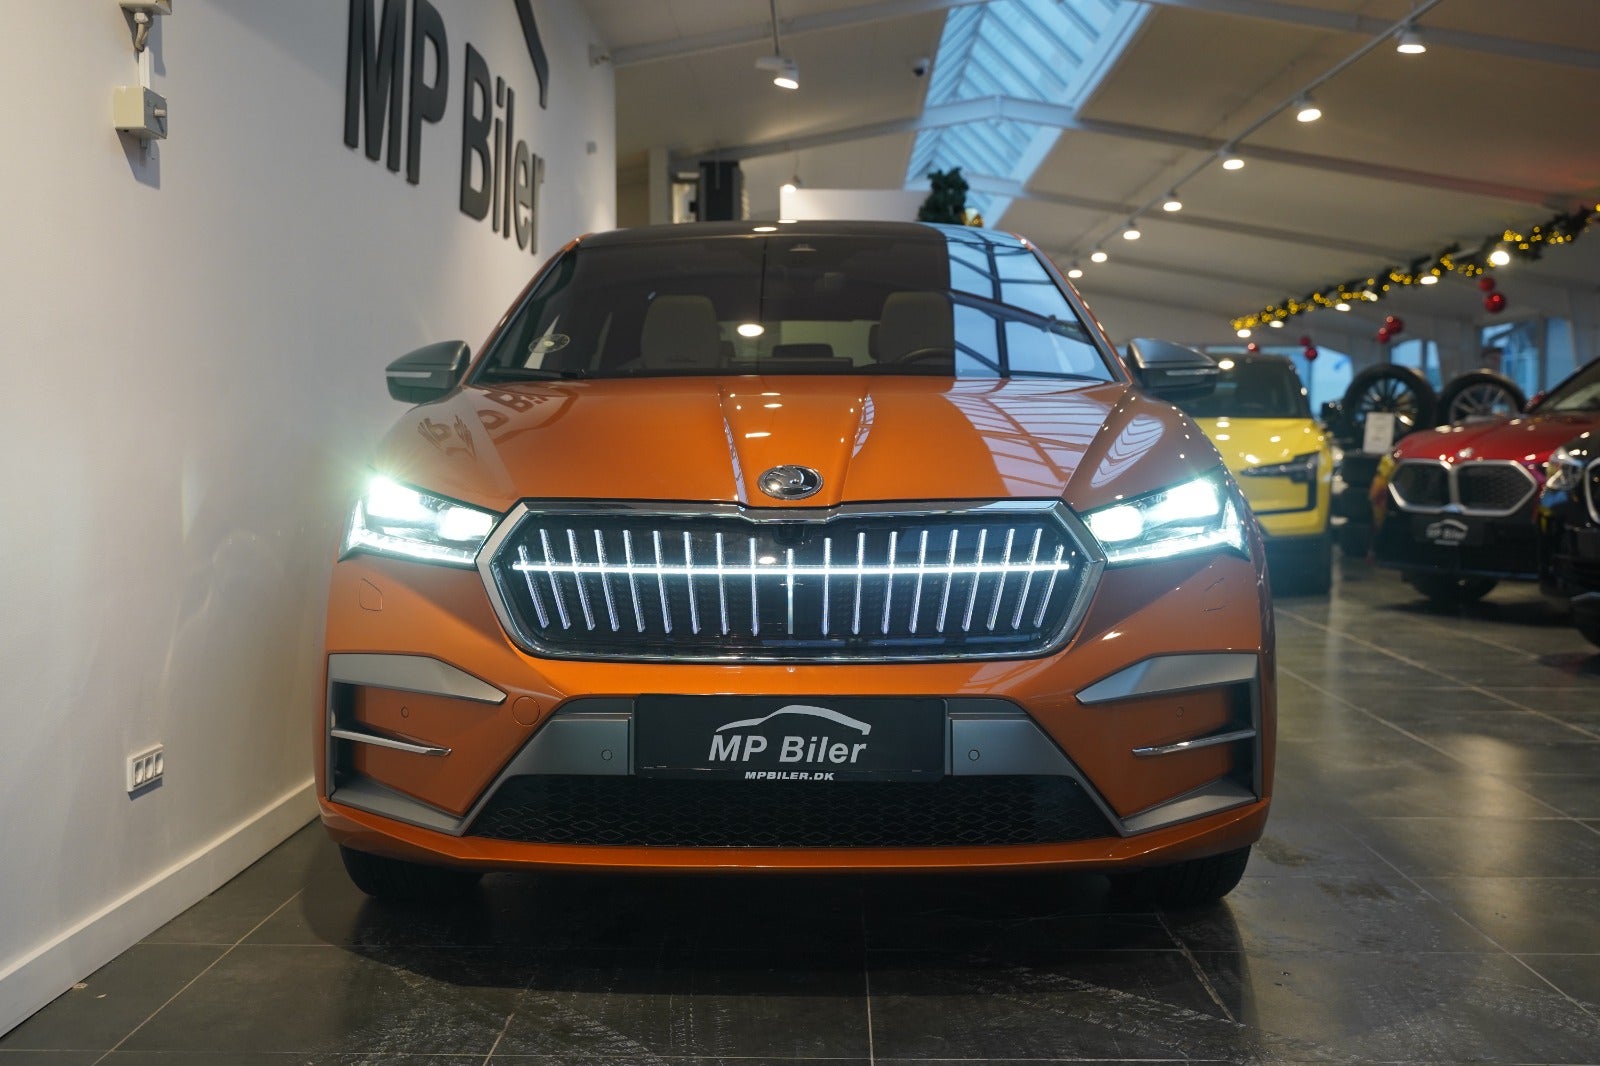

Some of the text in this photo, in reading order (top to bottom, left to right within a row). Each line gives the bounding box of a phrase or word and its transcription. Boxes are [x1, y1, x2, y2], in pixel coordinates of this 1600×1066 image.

[344, 0, 544, 255] MP Biler
[708, 734, 867, 763] MP Biler
[744, 771, 834, 781] MPBILER.DK
